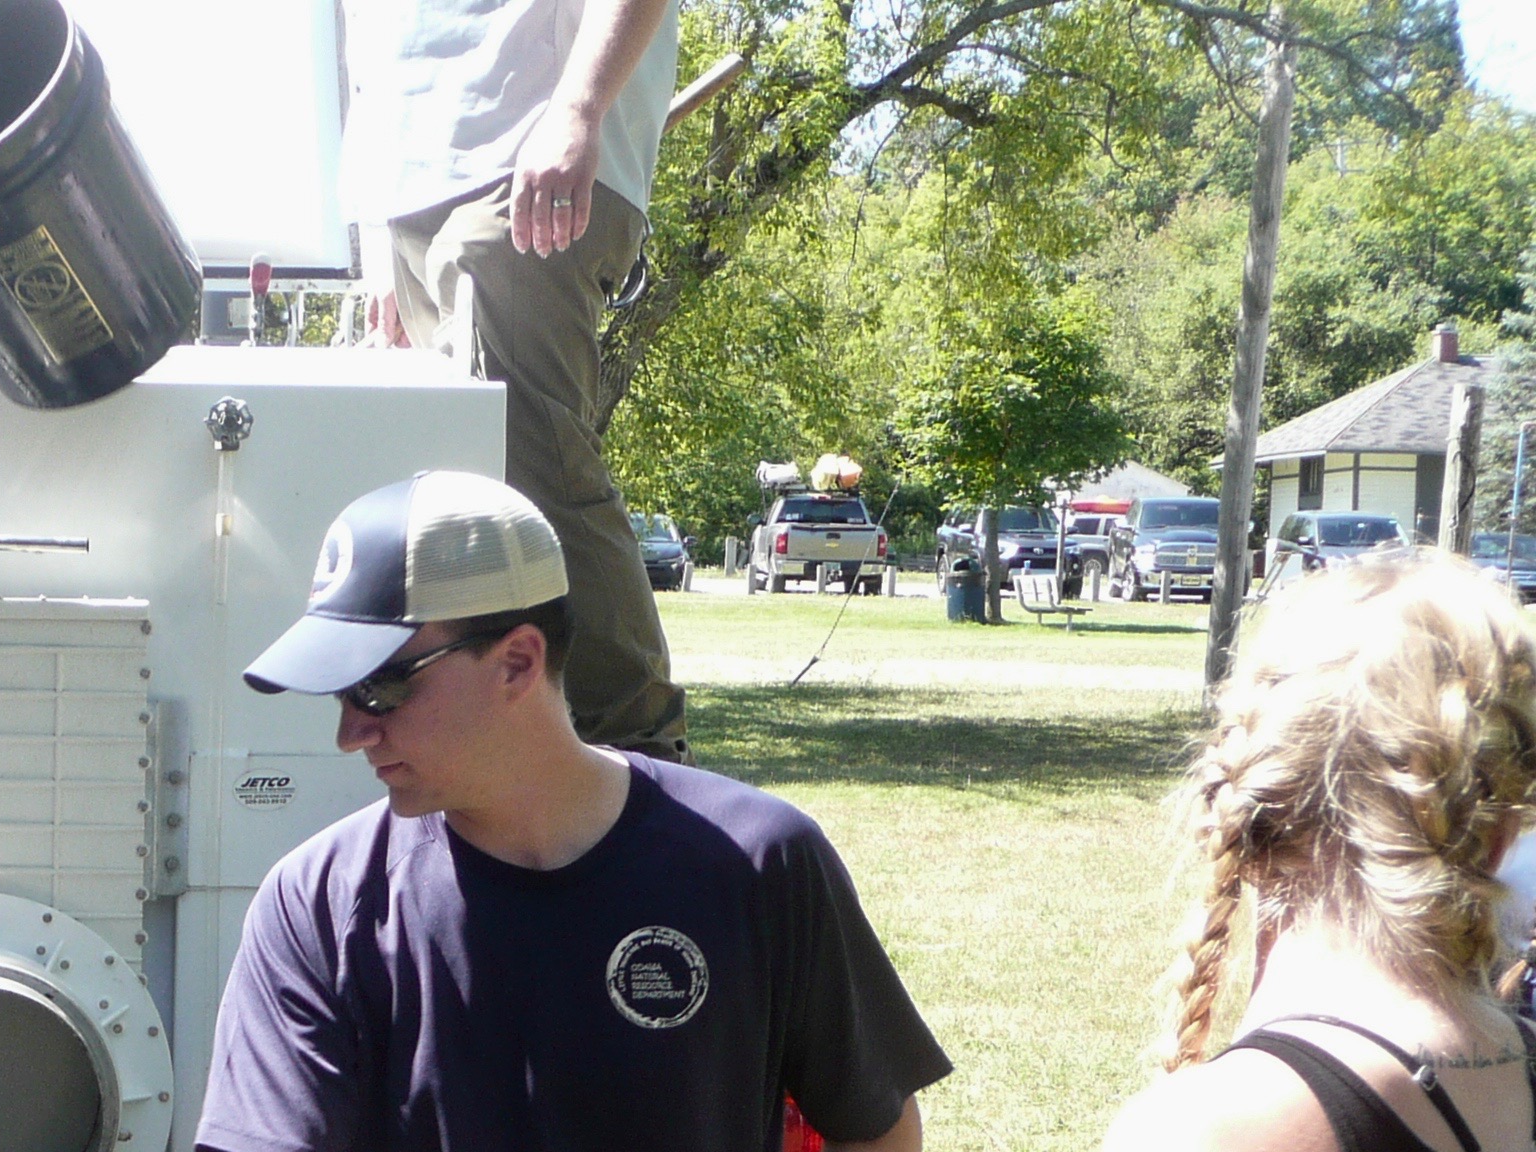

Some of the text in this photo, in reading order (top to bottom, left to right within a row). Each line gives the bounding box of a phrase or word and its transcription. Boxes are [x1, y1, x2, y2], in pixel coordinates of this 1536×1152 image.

[241, 777, 290, 787] JETCO
[630, 972, 670, 980] NATURAL
[632, 990, 685, 999] DEPARTMENT
